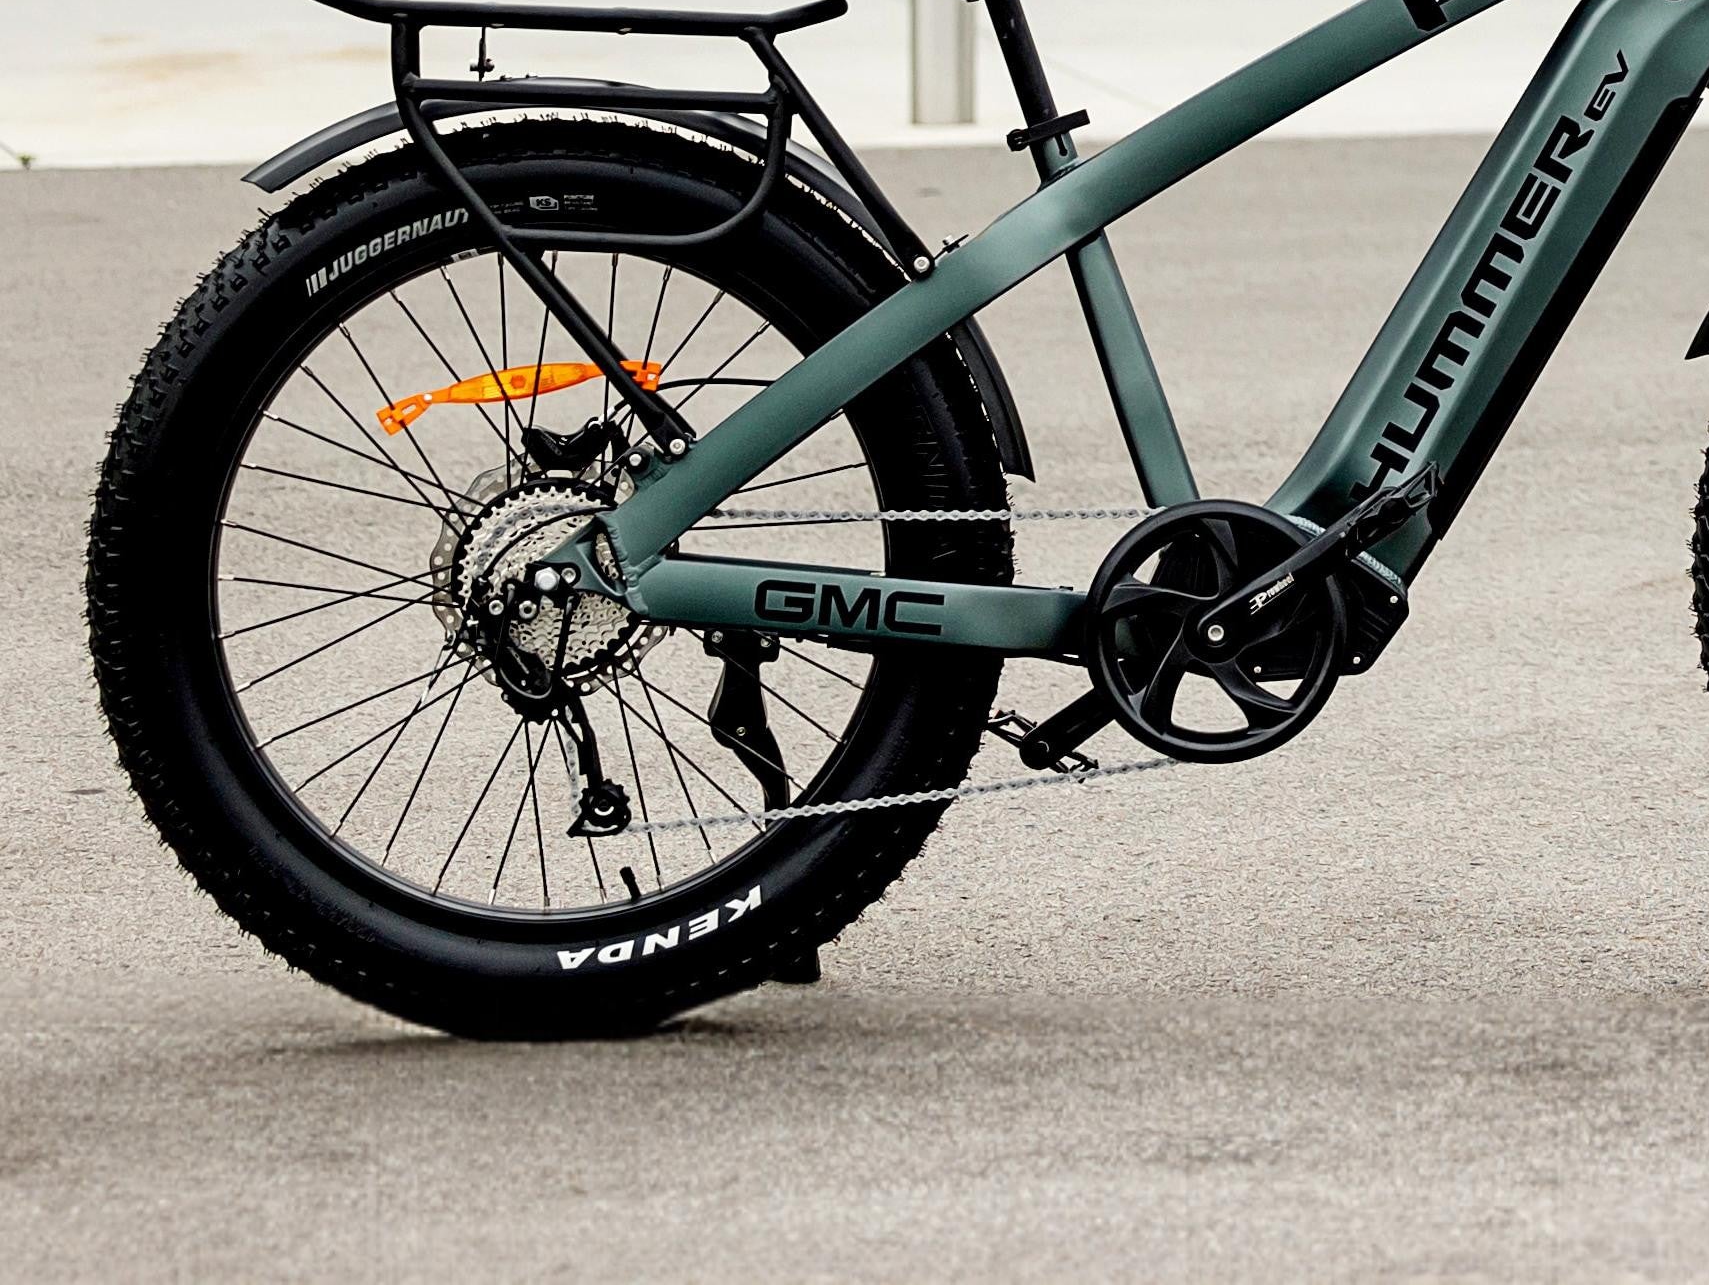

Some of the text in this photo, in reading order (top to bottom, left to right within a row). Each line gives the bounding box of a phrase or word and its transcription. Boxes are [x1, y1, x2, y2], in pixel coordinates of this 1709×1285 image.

[1348, 48, 1629, 504] HUMMER EV
[753, 578, 946, 637] GMC
[556, 884, 762, 970] KENDA
